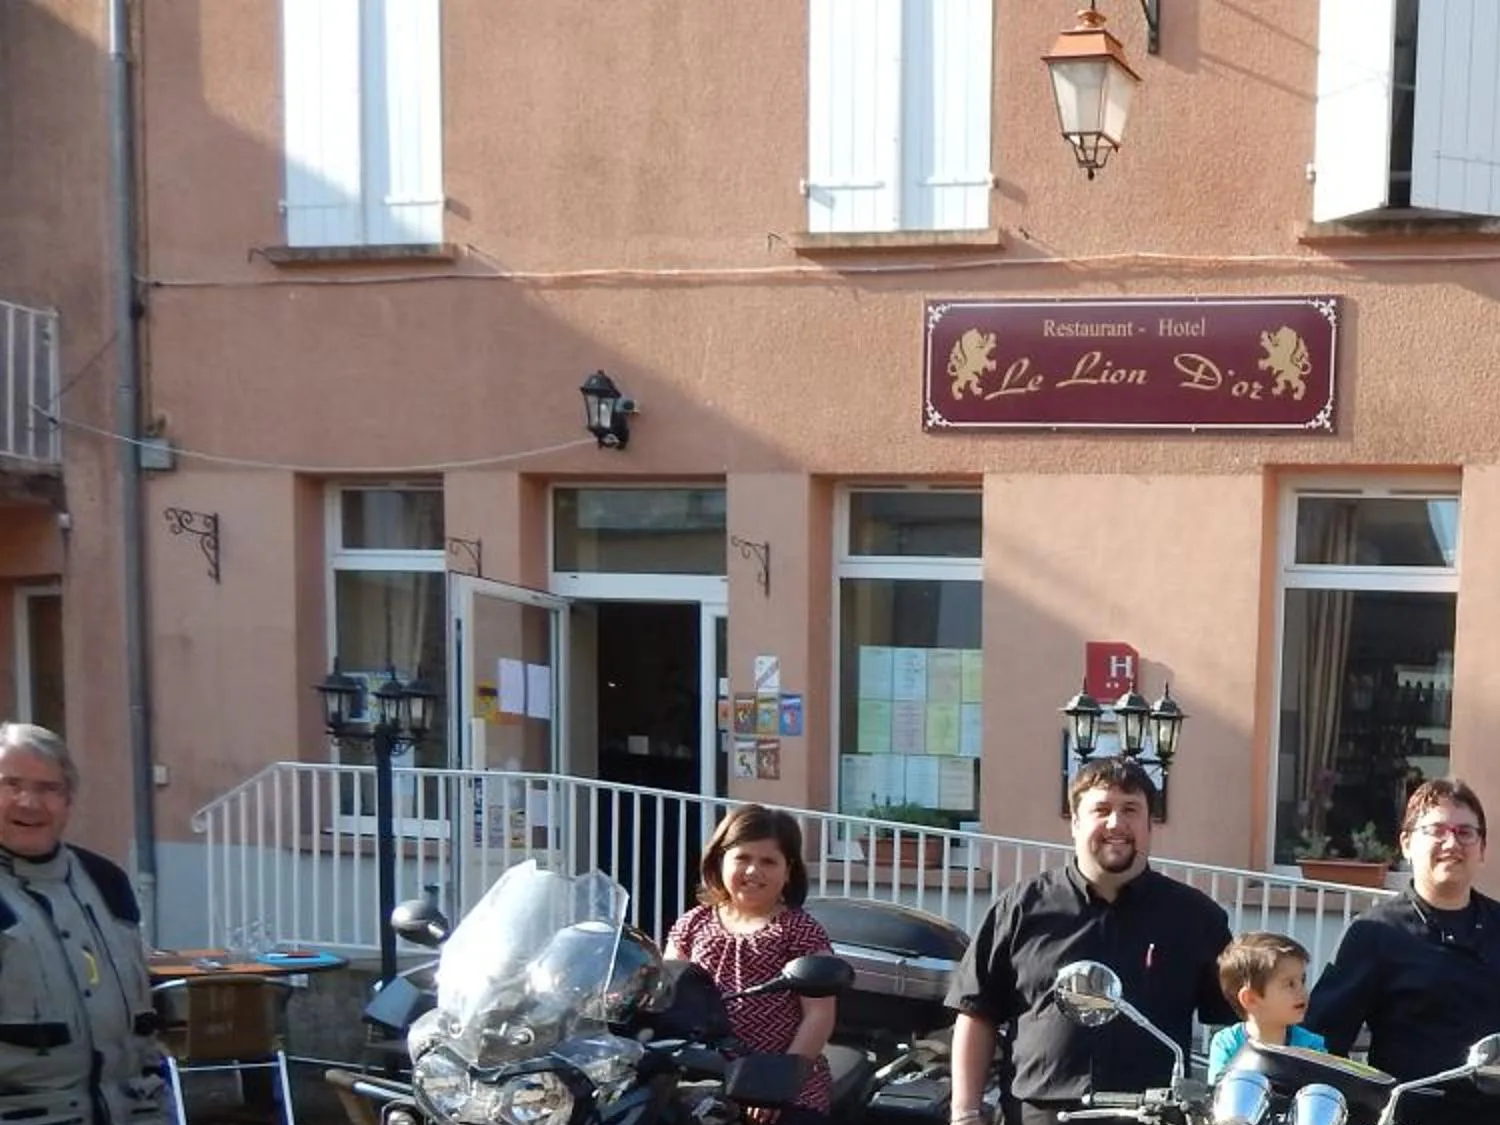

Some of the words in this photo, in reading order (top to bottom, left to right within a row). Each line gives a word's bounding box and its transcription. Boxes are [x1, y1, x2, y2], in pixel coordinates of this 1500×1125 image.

[1043, 319, 1133, 338] Restaurant
[1158, 317, 1206, 338] Hotel
[984, 357, 1044, 400] Le
[1055, 351, 1148, 386] Lion
[1173, 353, 1264, 399] D'or
[1110, 655, 1133, 678] H
